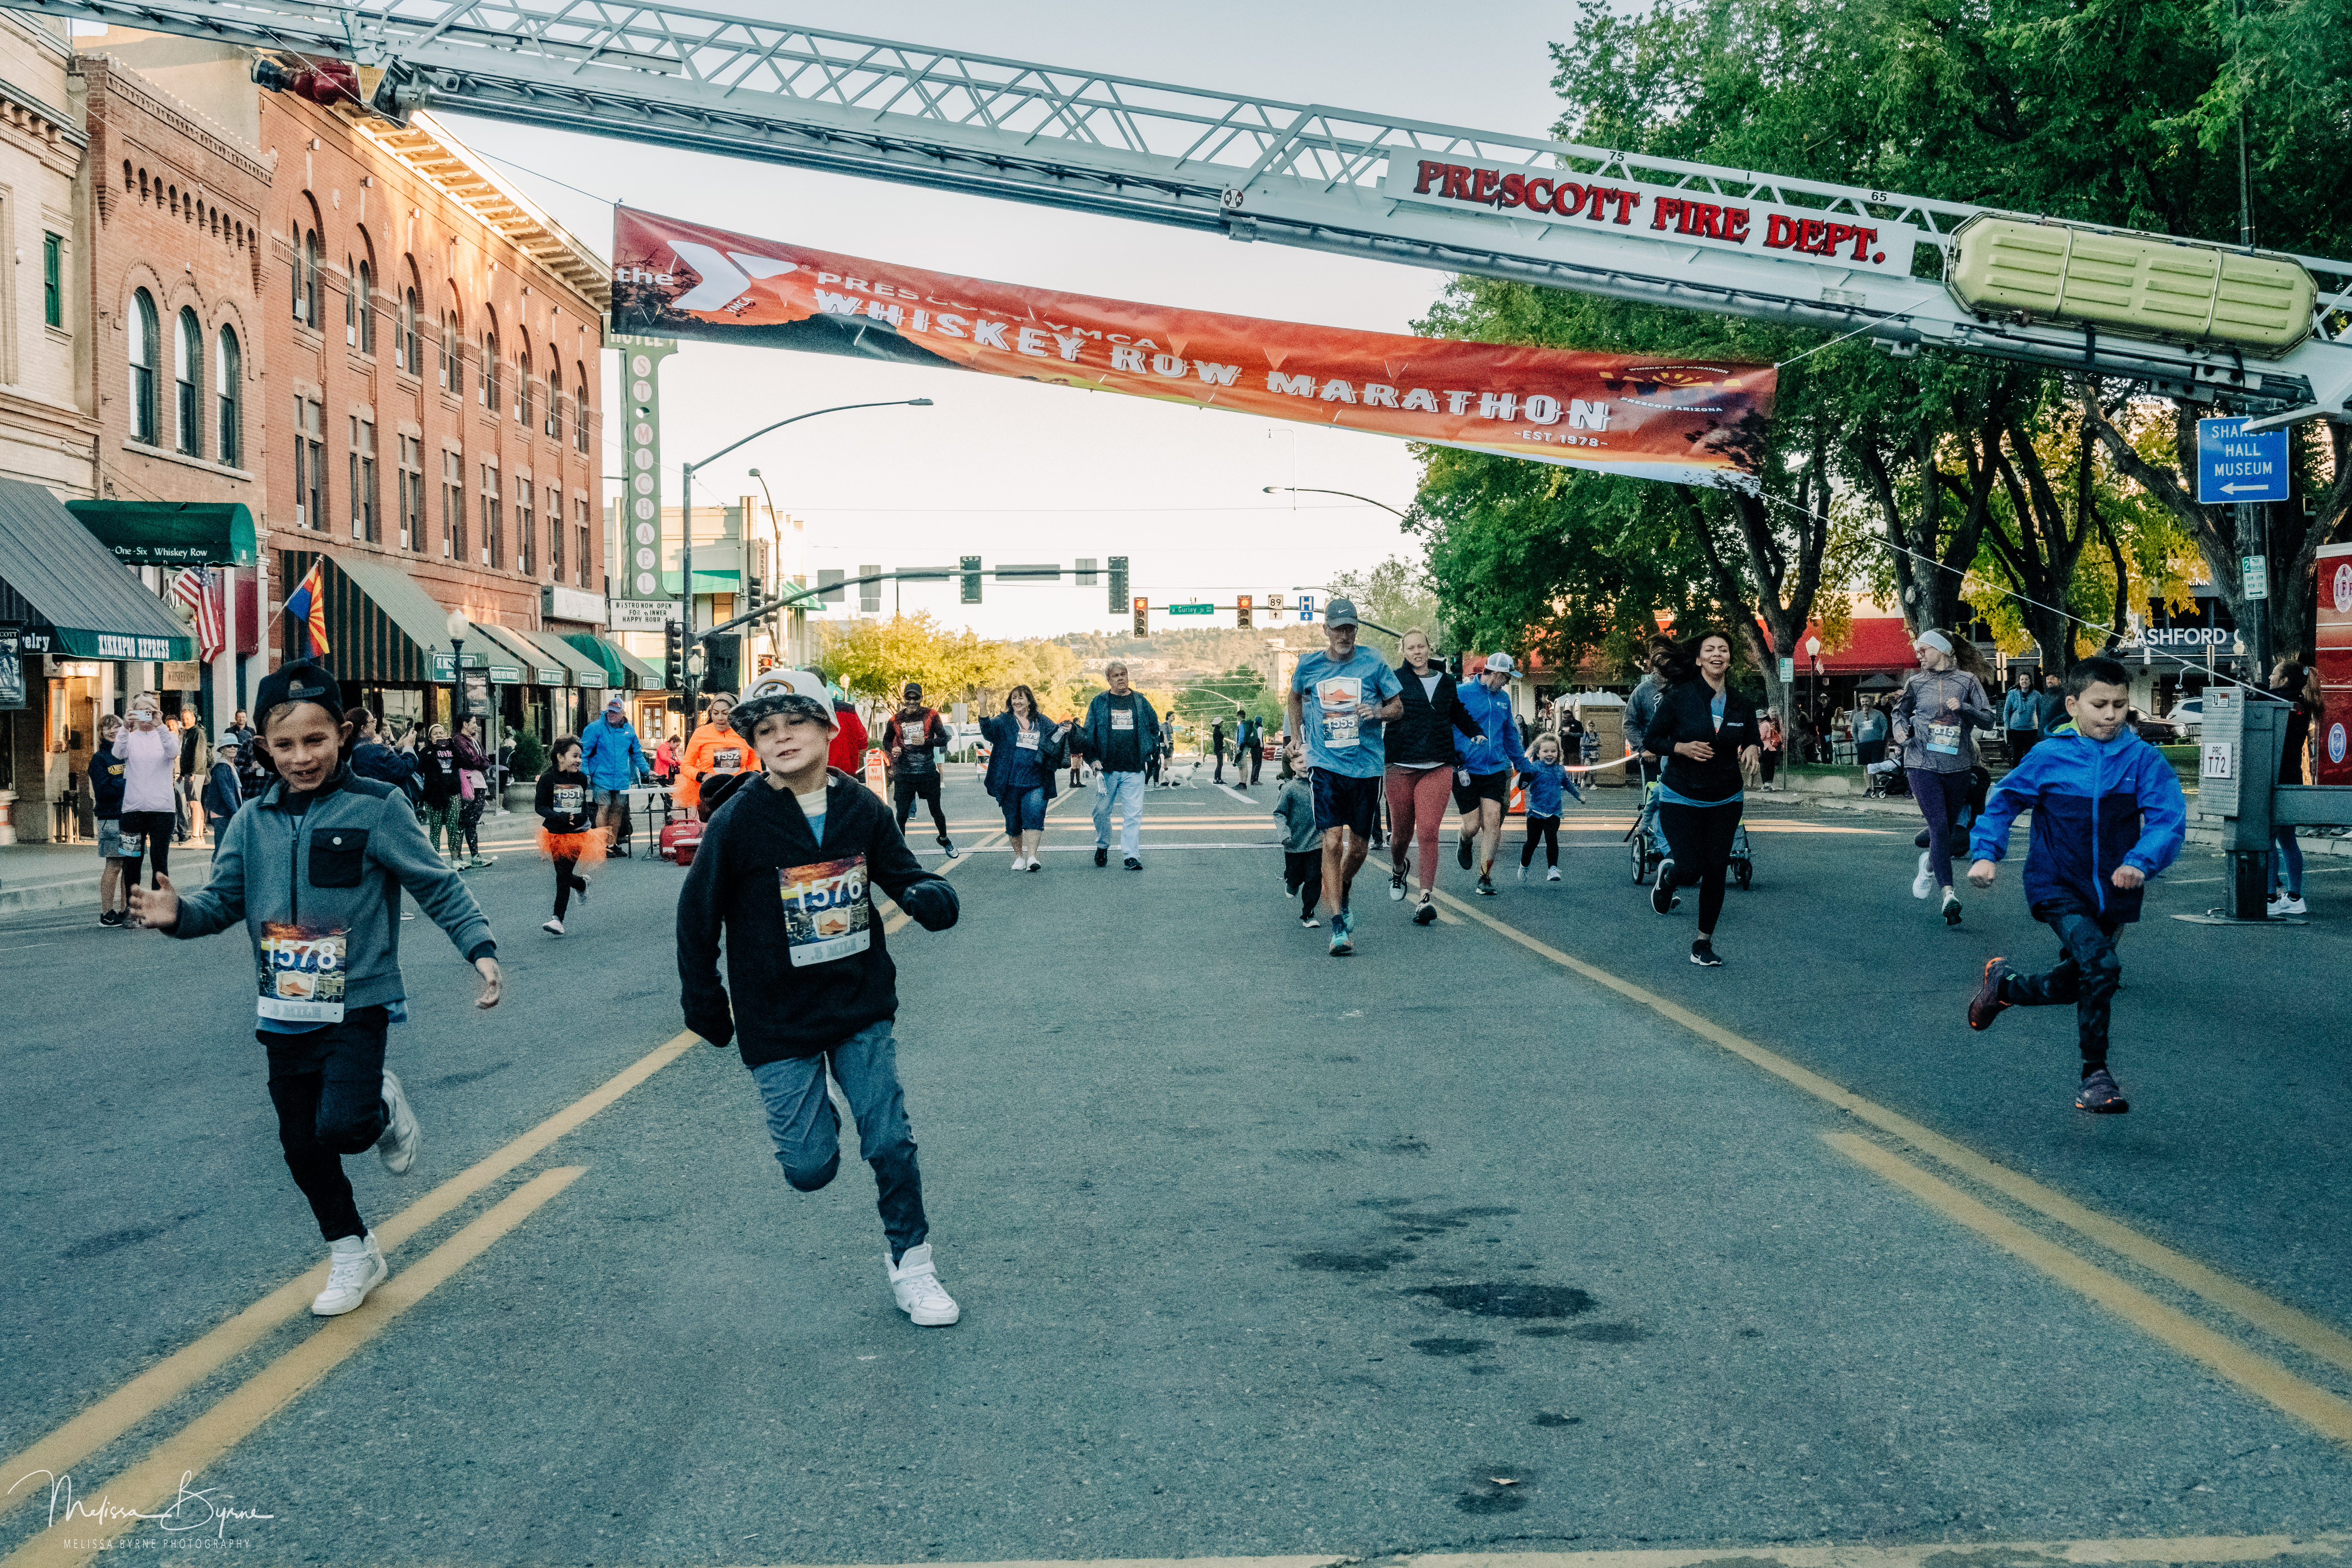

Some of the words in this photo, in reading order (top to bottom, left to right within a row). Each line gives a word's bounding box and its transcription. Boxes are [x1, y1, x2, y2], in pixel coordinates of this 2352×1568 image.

[1609, 151, 1625, 162] 75
[1871, 191, 1887, 202] 65
[1413, 160, 1640, 226] PRESCOTT
[1650, 196, 1750, 245] FIRE
[1763, 214, 1886, 265] DEPT.
[615, 267, 674, 286] the
[724, 296, 754, 313] YMCA
[818, 271, 1029, 322] PRES
[1043, 320, 1160, 350] YMCA
[813, 288, 1086, 362] WHISKEY
[1110, 345, 1242, 386] ROW
[1264, 371, 1612, 432] MARATHON
[1620, 397, 1673, 410] PRESCOTT
[2225, 442, 2261, 456] HALL
[2215, 462, 2272, 477] MUSEUM
[637, 426, 652, 593] MICHAEL
[154, 548, 188, 559] Whiskey
[2244, 561, 2250, 571] 2
[1178, 605, 1197, 614] Gurley
[1301, 597, 1312, 610] H
[2134, 628, 2226, 645] ASHFORD
[138, 638, 169, 659] EXPRESS
[168, 671, 185, 682] WHISKEY
[905, 724, 922, 733] 1557
[1327, 716, 1355, 730] 1555
[1934, 724, 1955, 736] 815
[716, 751, 739, 760] 1552
[2212, 747, 2222, 756] PRC
[2209, 756, 2225, 773] T72
[557, 788, 580, 798] 1551
[791, 871, 862, 910] 1576
[267, 937, 337, 969] 1578
